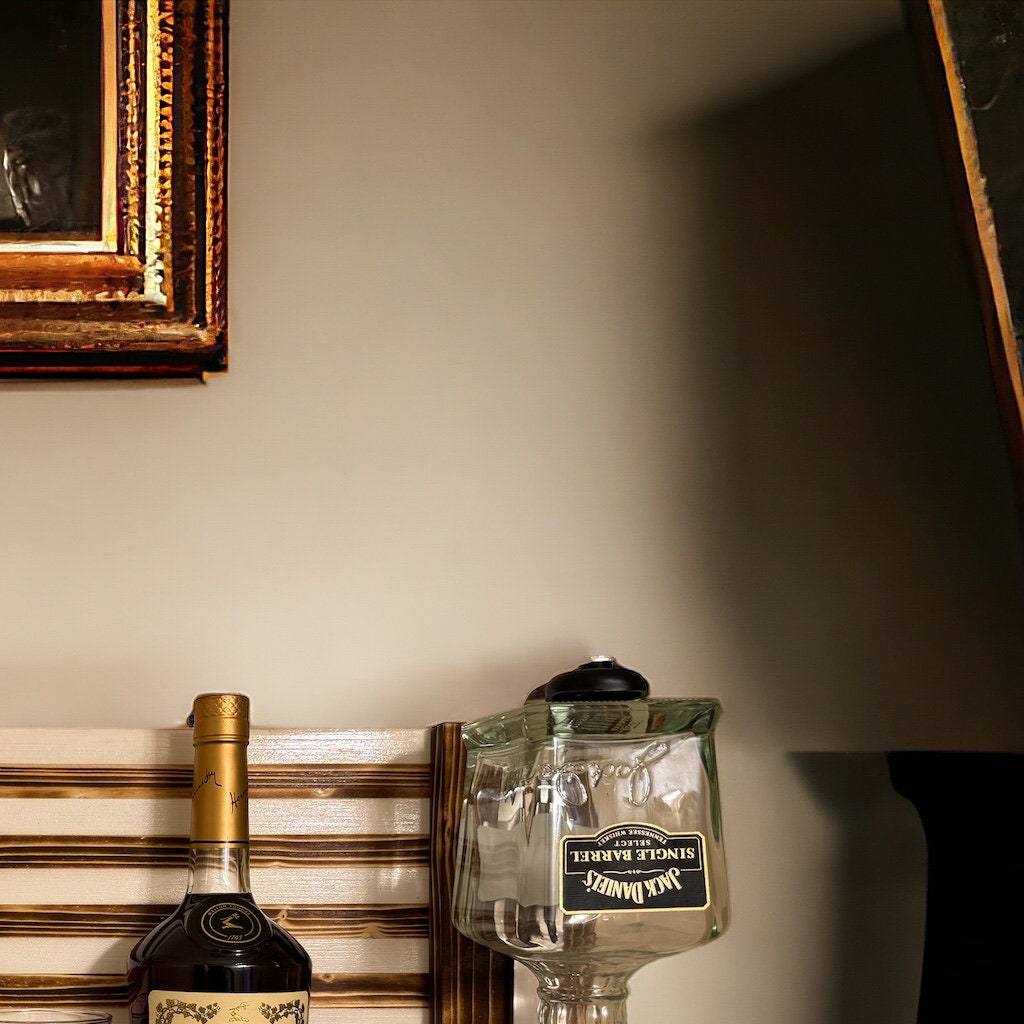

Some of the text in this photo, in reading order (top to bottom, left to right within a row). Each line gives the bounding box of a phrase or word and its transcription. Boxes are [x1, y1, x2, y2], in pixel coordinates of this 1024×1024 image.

[597, 829, 667, 847] TENNESSEE WHISKEY
[614, 839, 651, 847] SELECT
[570, 847, 695, 863] SINGLE BARREL
[582, 867, 683, 904] JACK DANIEL'S
